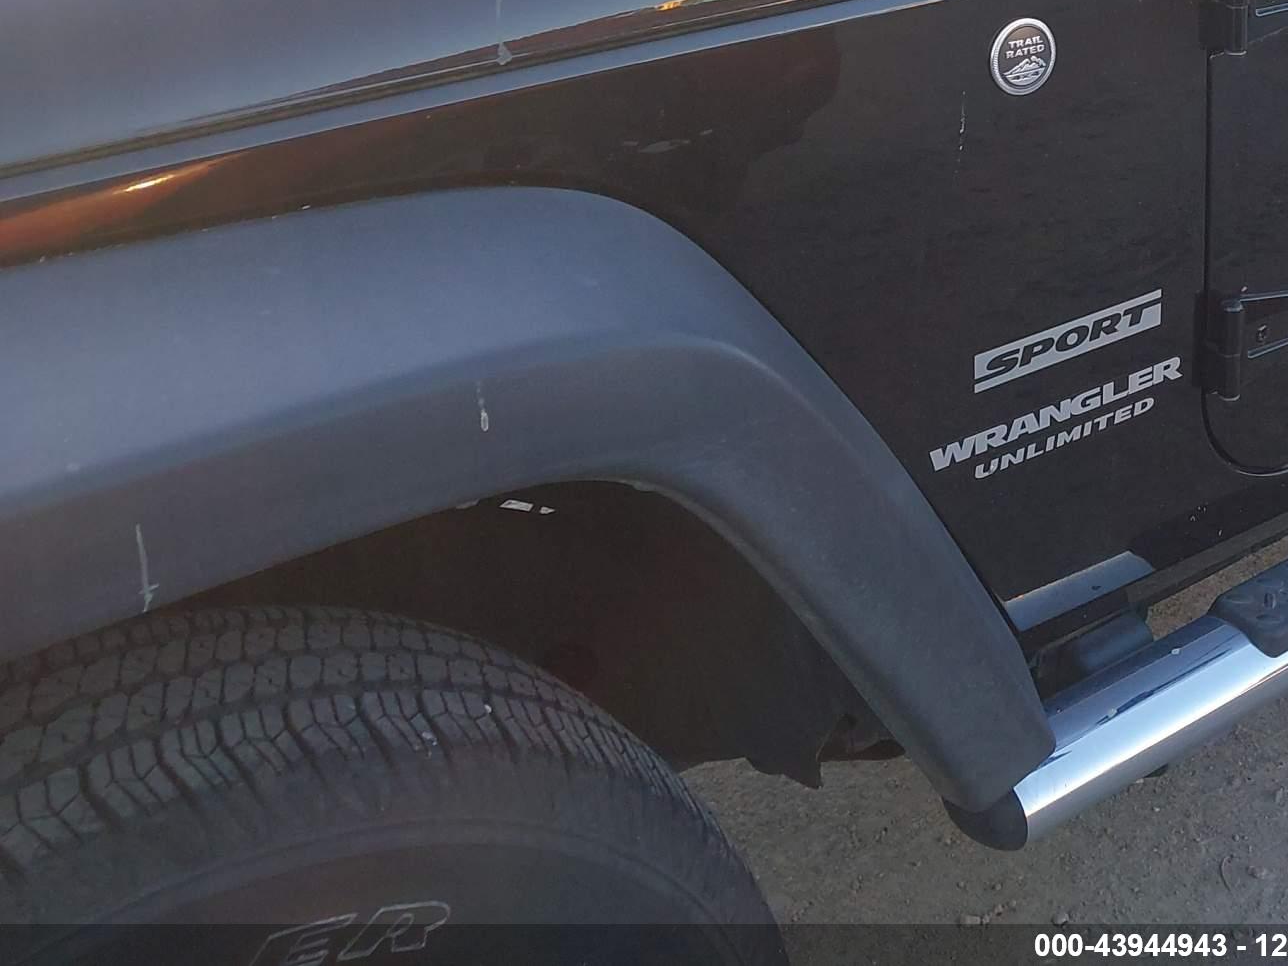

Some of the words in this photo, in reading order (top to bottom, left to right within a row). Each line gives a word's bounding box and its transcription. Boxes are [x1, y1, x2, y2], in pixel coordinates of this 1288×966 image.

[1005, 44, 1045, 59] RATED
[1007, 35, 1044, 49] TRAIL
[983, 300, 1156, 376] SPORT
[929, 356, 1183, 472] WRANGLER
[974, 397, 1156, 479] UNLIMITED
